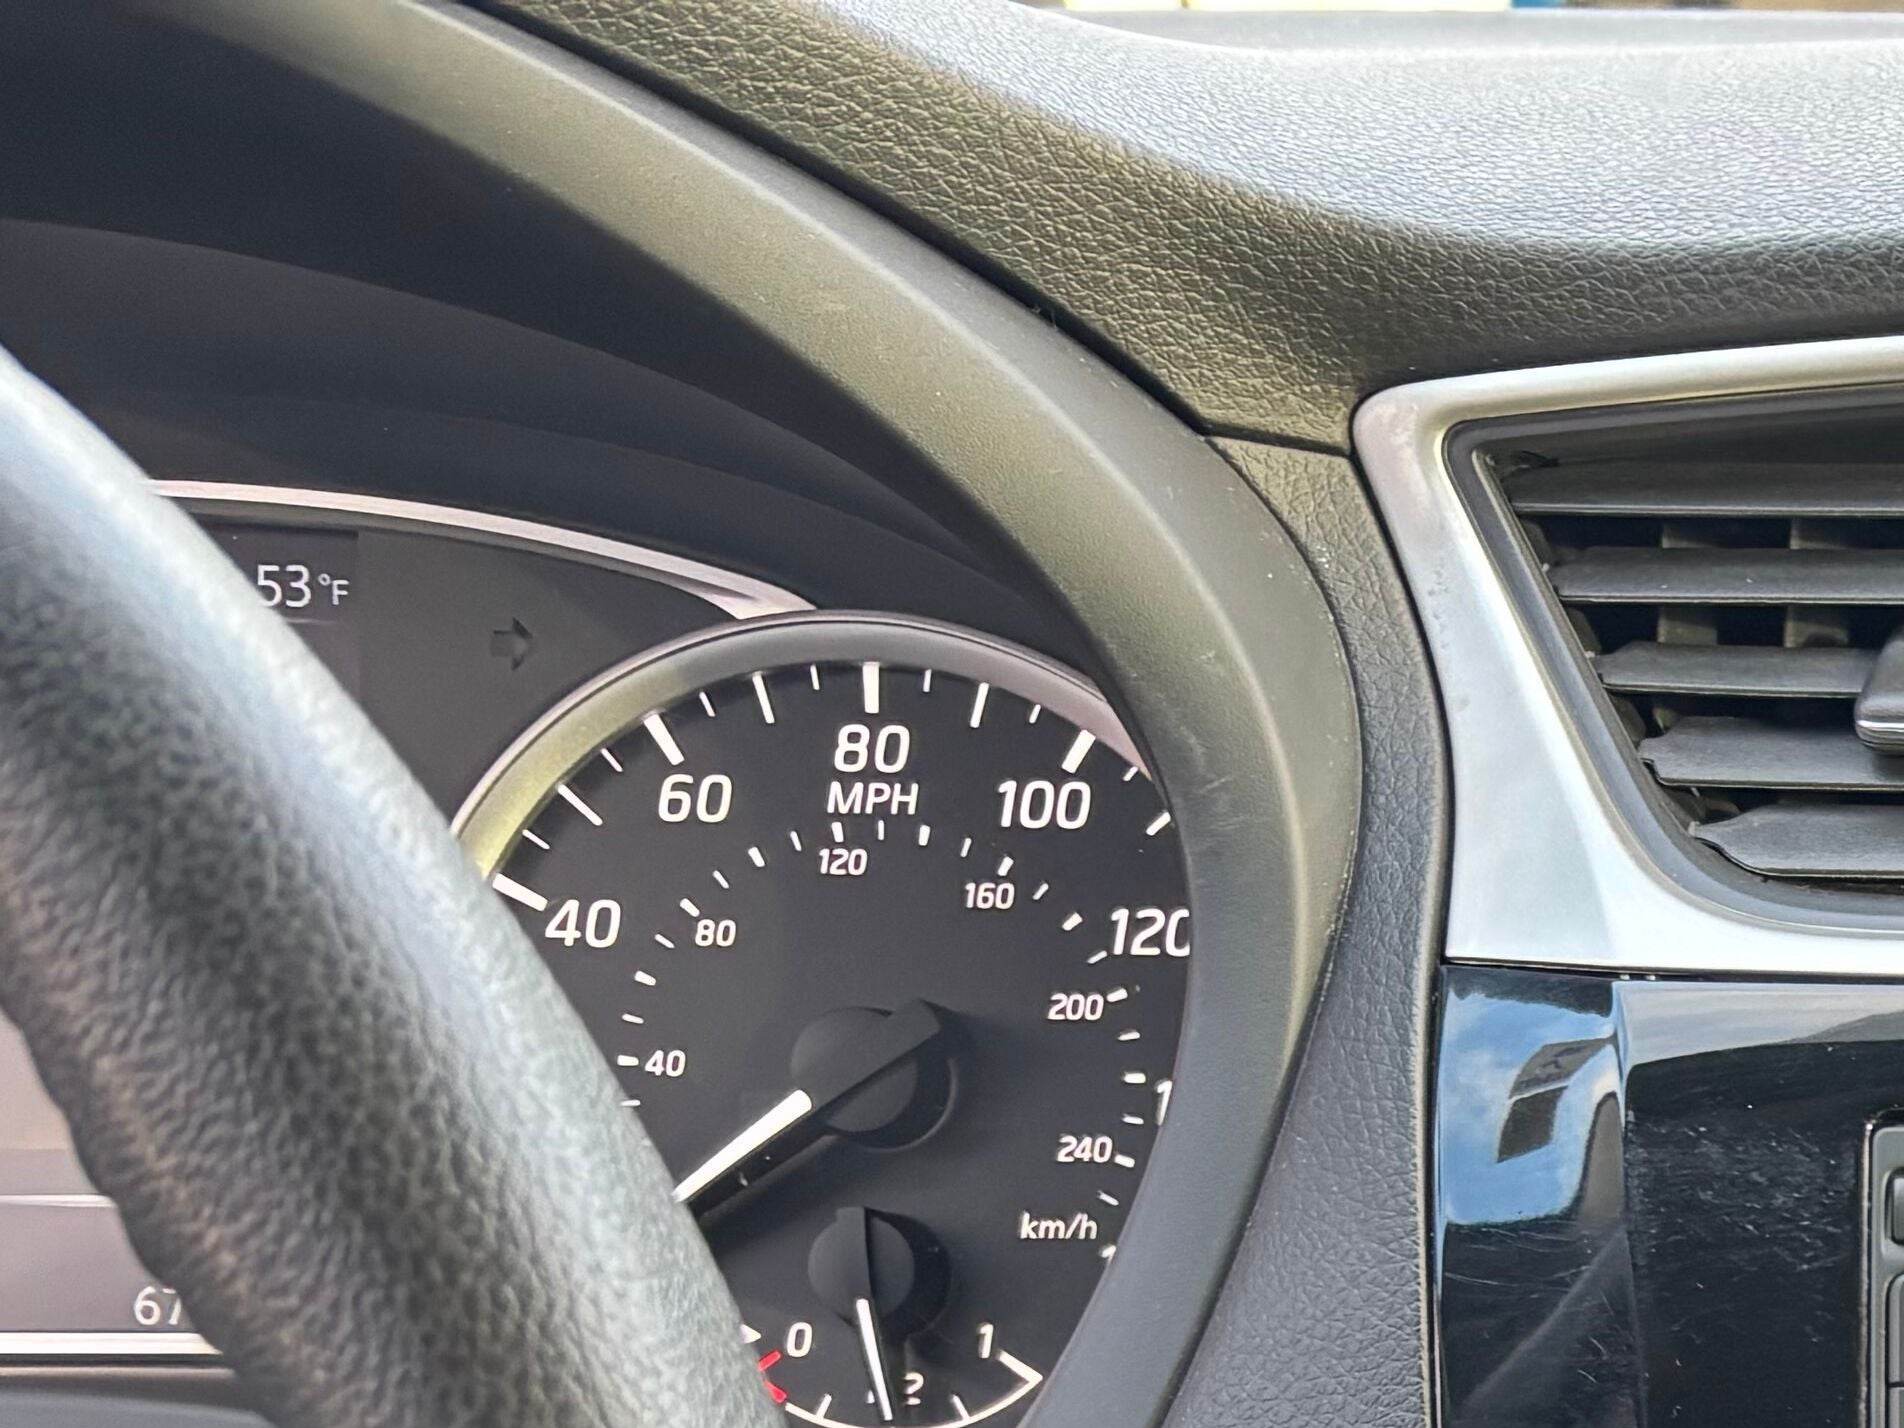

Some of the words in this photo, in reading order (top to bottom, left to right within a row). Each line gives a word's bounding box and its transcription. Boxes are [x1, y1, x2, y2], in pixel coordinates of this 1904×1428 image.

[833, 723, 910, 774] 80
[658, 773, 732, 823] 60
[826, 780, 919, 815] MPH
[998, 780, 1091, 830] 100
[819, 848, 868, 876] 120
[965, 882, 1015, 910] 160
[544, 899, 621, 948] 40
[694, 919, 737, 947] 80
[1111, 908, 1191, 957] 120
[1047, 993, 1104, 1021] 200
[644, 1049, 686, 1077] 40
[1057, 1135, 1113, 1163] 240
[1020, 1212, 1098, 1240] km/h
[787, 1321, 814, 1358] 0
[977, 1323, 995, 1359] 1
